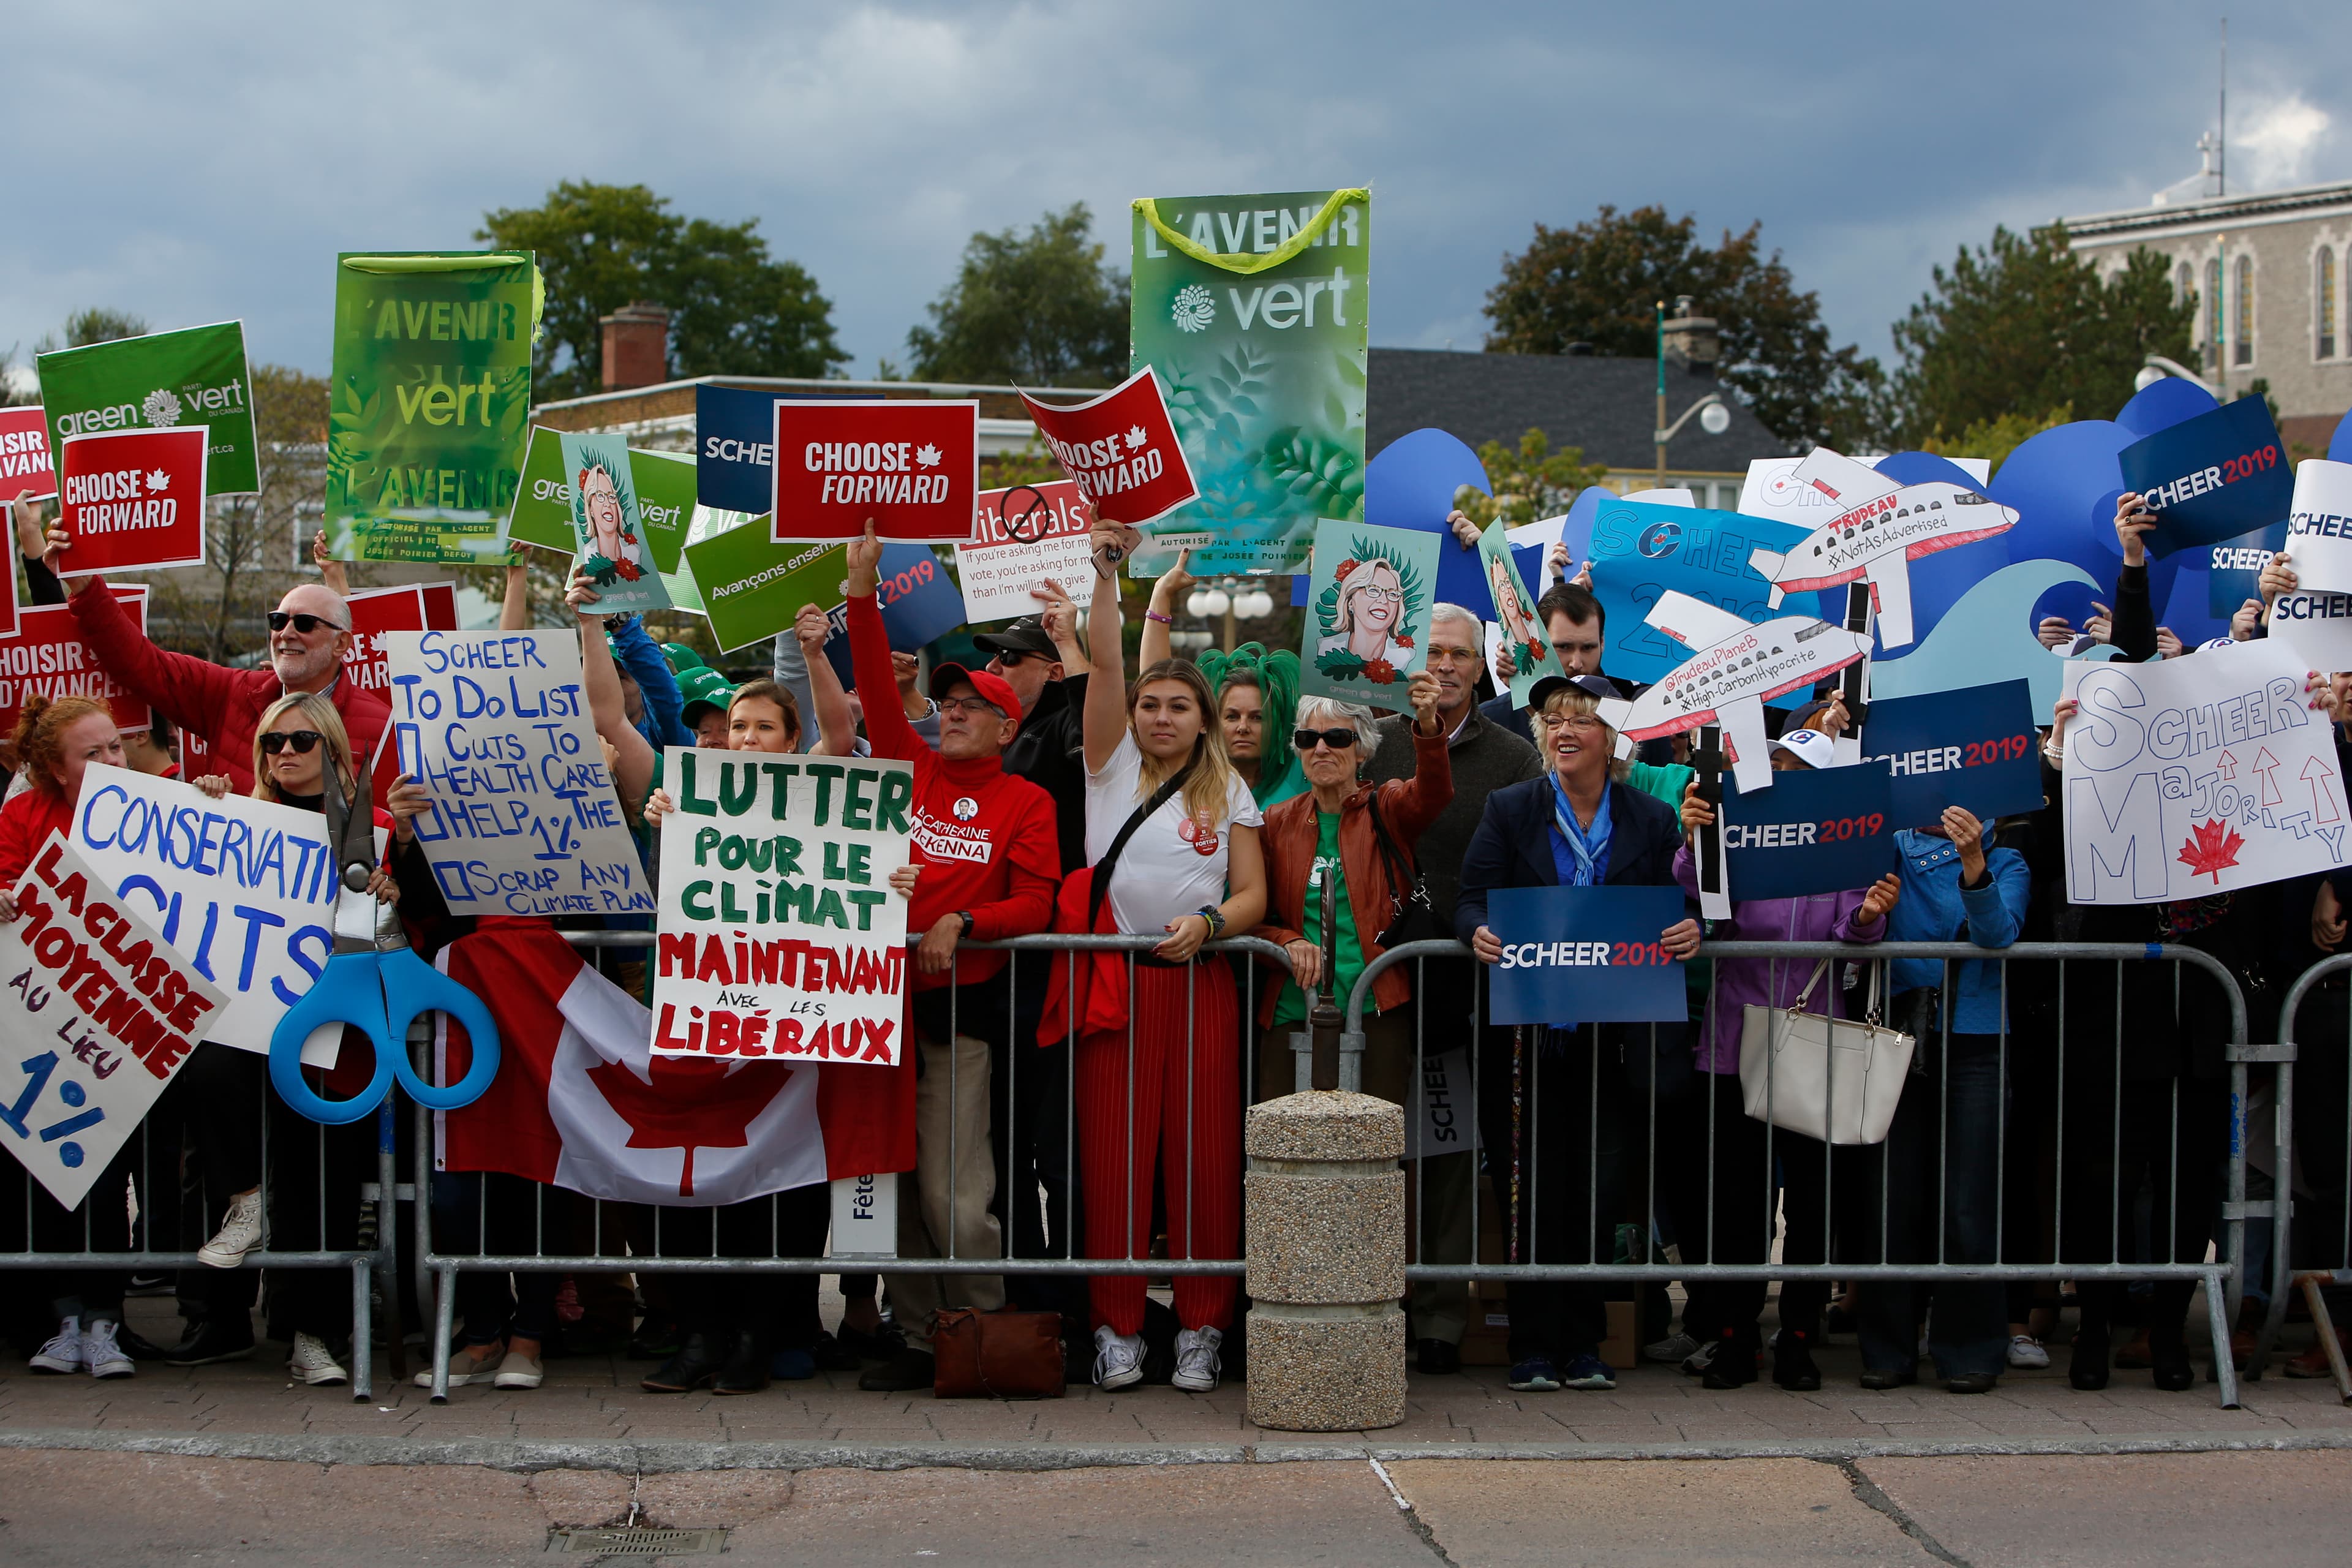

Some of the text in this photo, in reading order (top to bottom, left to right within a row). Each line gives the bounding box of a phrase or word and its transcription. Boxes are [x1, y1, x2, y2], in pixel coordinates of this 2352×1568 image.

[1229, 266, 1350, 330] vert
[344, 299, 517, 341] L'AVENIR
[183, 382, 202, 392] PARTI
[396, 371, 496, 427] vert
[57, 378, 244, 437] green vert
[208, 407, 244, 418] DU CANADA
[805, 442, 911, 472] CHOOSE
[2223, 445, 2277, 484] 2019
[67, 469, 141, 505] CHOOSE
[821, 475, 949, 504] FORWARD
[78, 497, 178, 536] FORWARD
[639, 502, 680, 526] vert
[655, 522, 676, 532] CANADA
[973, 497, 1084, 548] iberals
[1828, 494, 1898, 535] TRUDEAU
[366, 546, 394, 556] JOSÉE
[400, 549, 437, 559] POIRIER
[966, 551, 973, 564] If
[976, 548, 1006, 565] you're
[1009, 543, 1041, 557] asking
[1044, 541, 1059, 552] me
[1061, 538, 1076, 550] for
[1161, 535, 1210, 547] AUTORISÉ
[1222, 549, 1254, 560] JOSÉE
[1828, 515, 1948, 571] #NotAsAdvertised
[2212, 547, 2274, 570] SCHEER
[712, 564, 786, 601] Avançons
[881, 560, 934, 605] 2019
[970, 569, 995, 581] vote,
[997, 562, 1028, 579] you're
[1030, 558, 1062, 573] asking
[1065, 555, 1078, 567] for
[973, 585, 997, 599] than
[999, 582, 1014, 595] I'm
[1016, 578, 1051, 592] willing
[1065, 574, 1088, 588] give.
[605, 592, 626, 603] green
[420, 631, 547, 674] SCHEER
[1665, 634, 1758, 692] @TrudeauPlaneB
[0, 671, 133, 709] D'AVANCE
[509, 675, 580, 718] LIST
[694, 671, 714, 685] green
[1329, 686, 1392, 701] green vert
[1681, 650, 1816, 712] #High-CarbonHypocrite
[2073, 667, 2309, 772] SCHEER
[1964, 735, 2028, 768] 2019
[424, 753, 611, 797] HEALTH CARE
[680, 751, 913, 835] LUTTER
[449, 790, 622, 839] HELP THE
[922, 814, 991, 841] CATHERINE
[1819, 813, 1885, 844] 2019
[530, 815, 581, 861] 1%
[695, 826, 872, 886] POUR LE
[1195, 838, 1218, 848] FORTIER
[466, 859, 631, 897] SCRAP ANY
[505, 890, 656, 914] CLIMATE PLAN
[34, 841, 216, 1036] LA CLASSE
[1499, 941, 1610, 970] SCHEER
[9, 882, 193, 1080] MOYENNE
[9, 967, 51, 1013] AU
[717, 989, 827, 1017] AVEC LES
[0, 1050, 106, 1169] 1%
[853, 1173, 874, 1219] Fête
